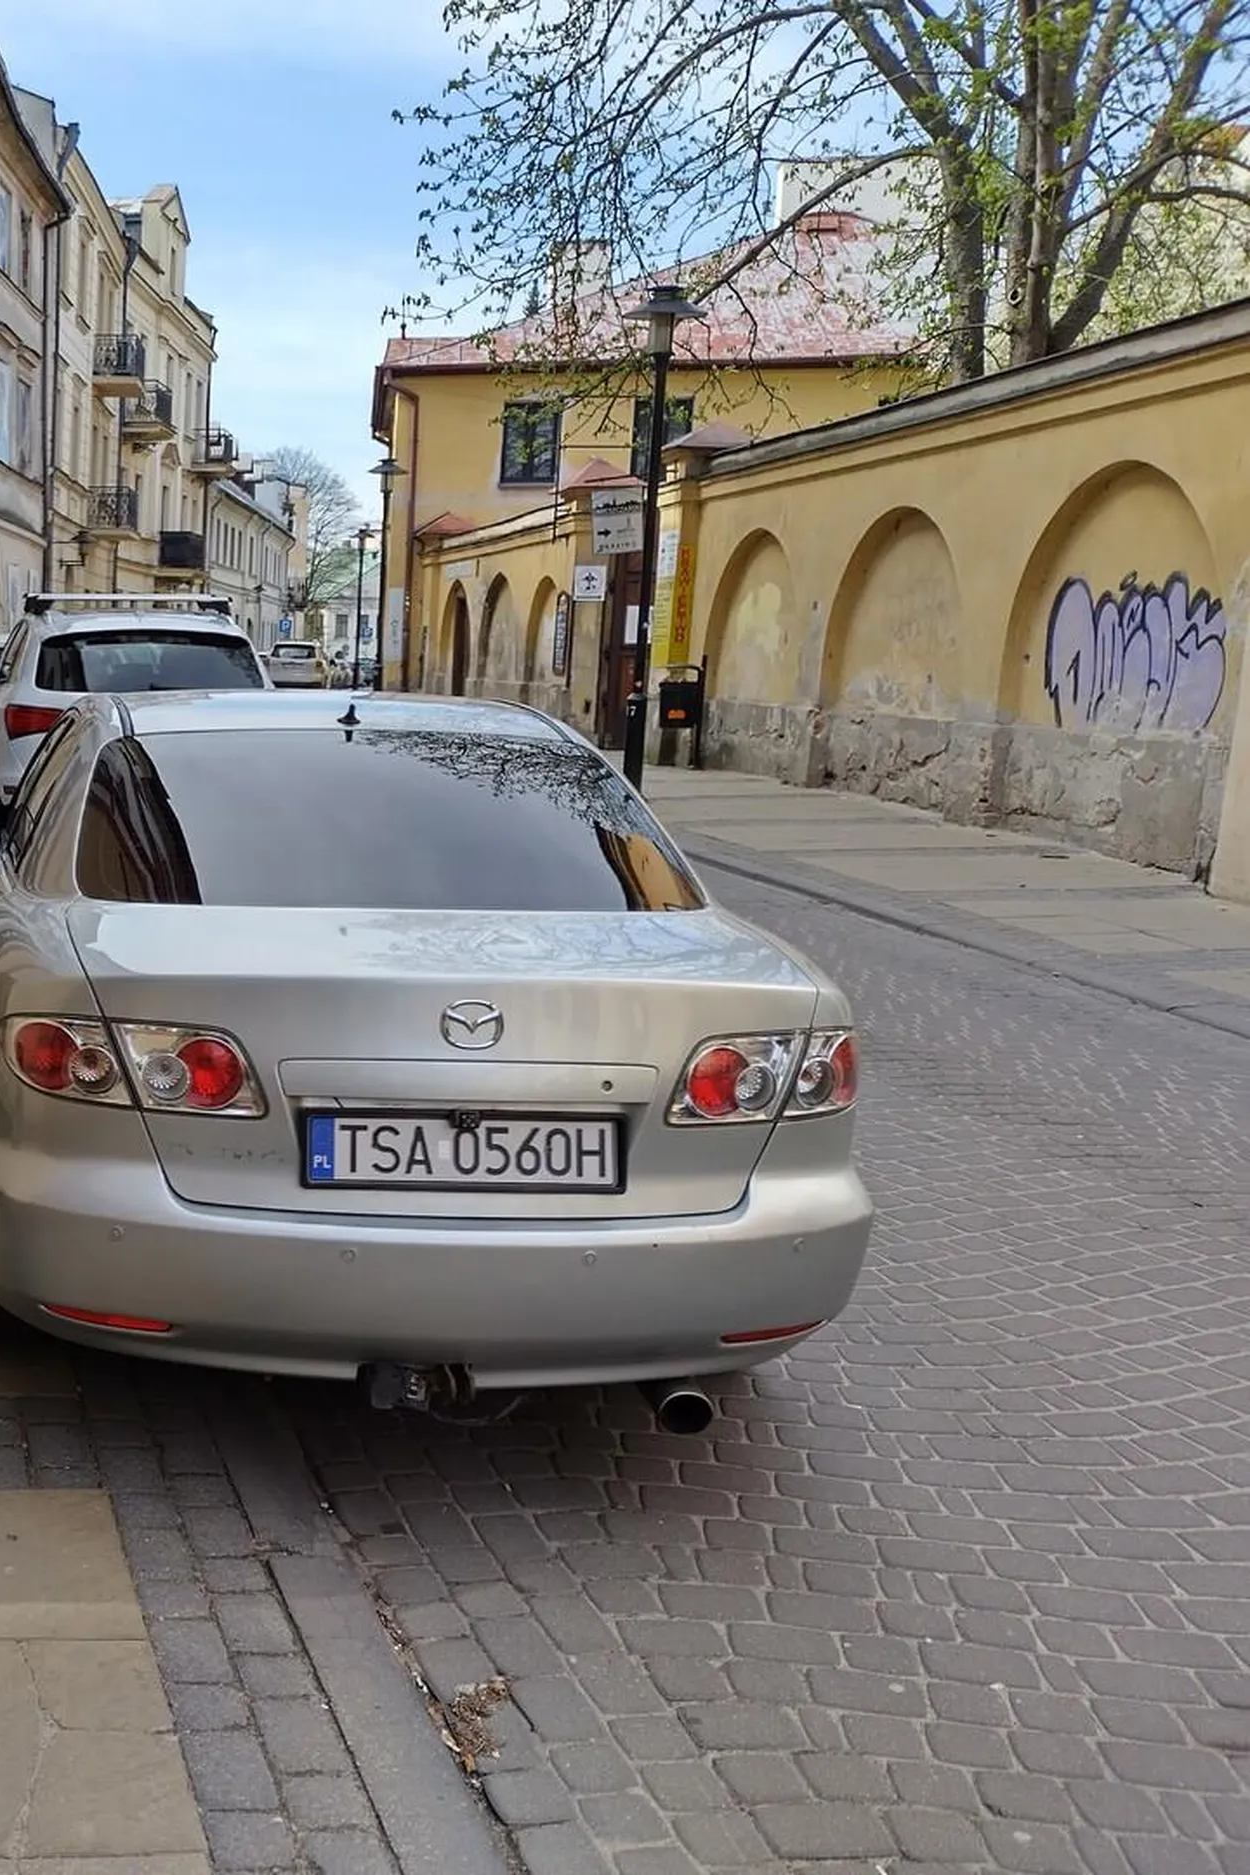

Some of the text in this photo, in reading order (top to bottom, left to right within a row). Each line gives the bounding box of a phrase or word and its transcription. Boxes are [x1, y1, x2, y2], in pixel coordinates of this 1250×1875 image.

[313, 1155, 332, 1169] PL
[339, 1124, 607, 1178] TSA 0560H
